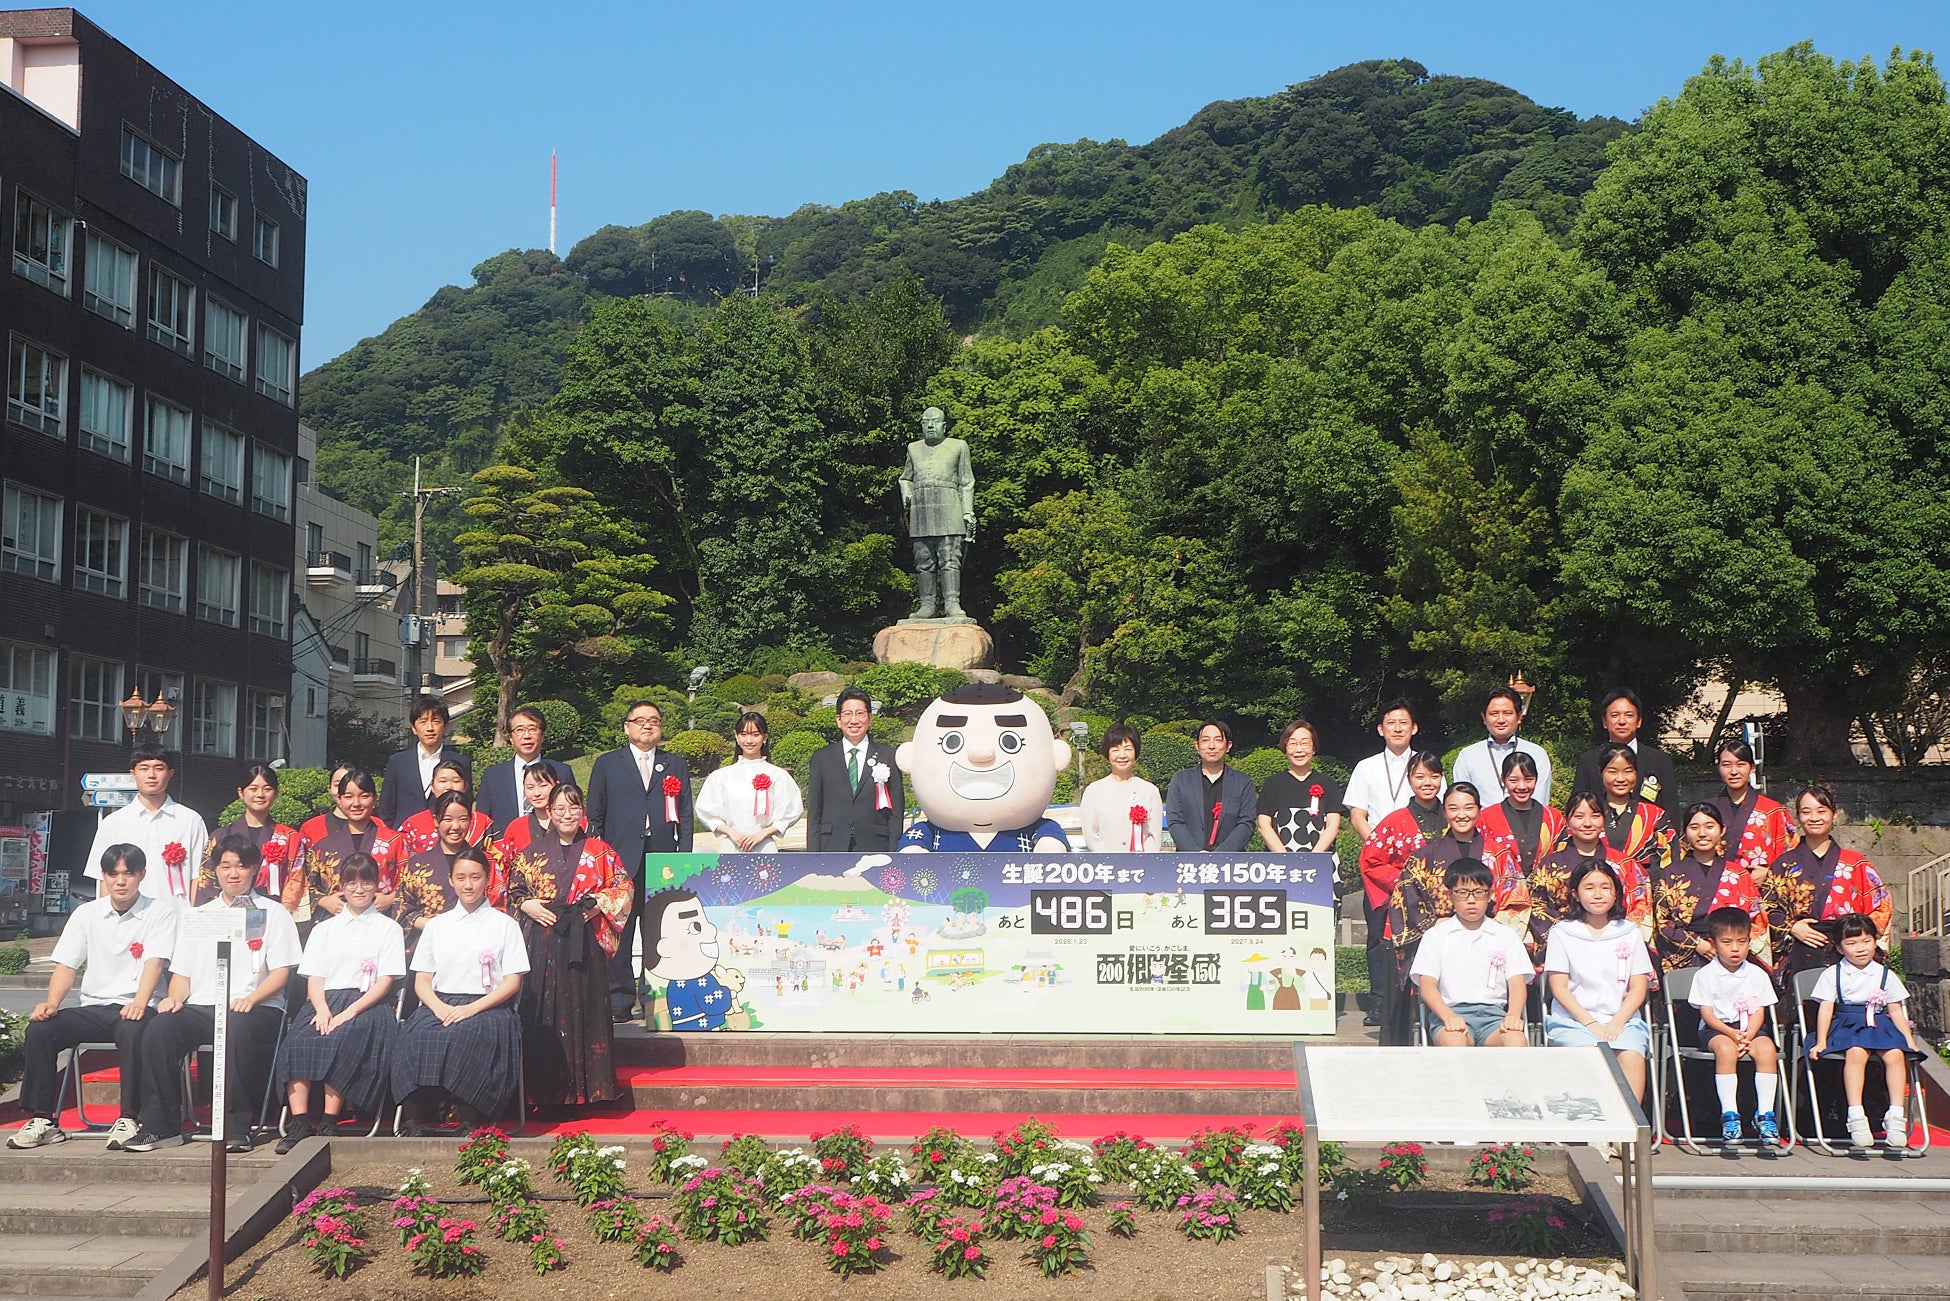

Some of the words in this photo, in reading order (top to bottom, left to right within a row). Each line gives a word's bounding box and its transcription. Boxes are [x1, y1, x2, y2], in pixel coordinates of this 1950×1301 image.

[1002, 863, 1144, 884] 生誕200年まで
[1176, 863, 1317, 884] 没後150年まで
[998, 915, 1025, 929] あと
[1035, 896, 1108, 929] 486
[1117, 911, 1134, 930] 日
[1171, 915, 1198, 929] あと
[1210, 895, 1281, 929] 365
[1291, 911, 1308, 930] 日
